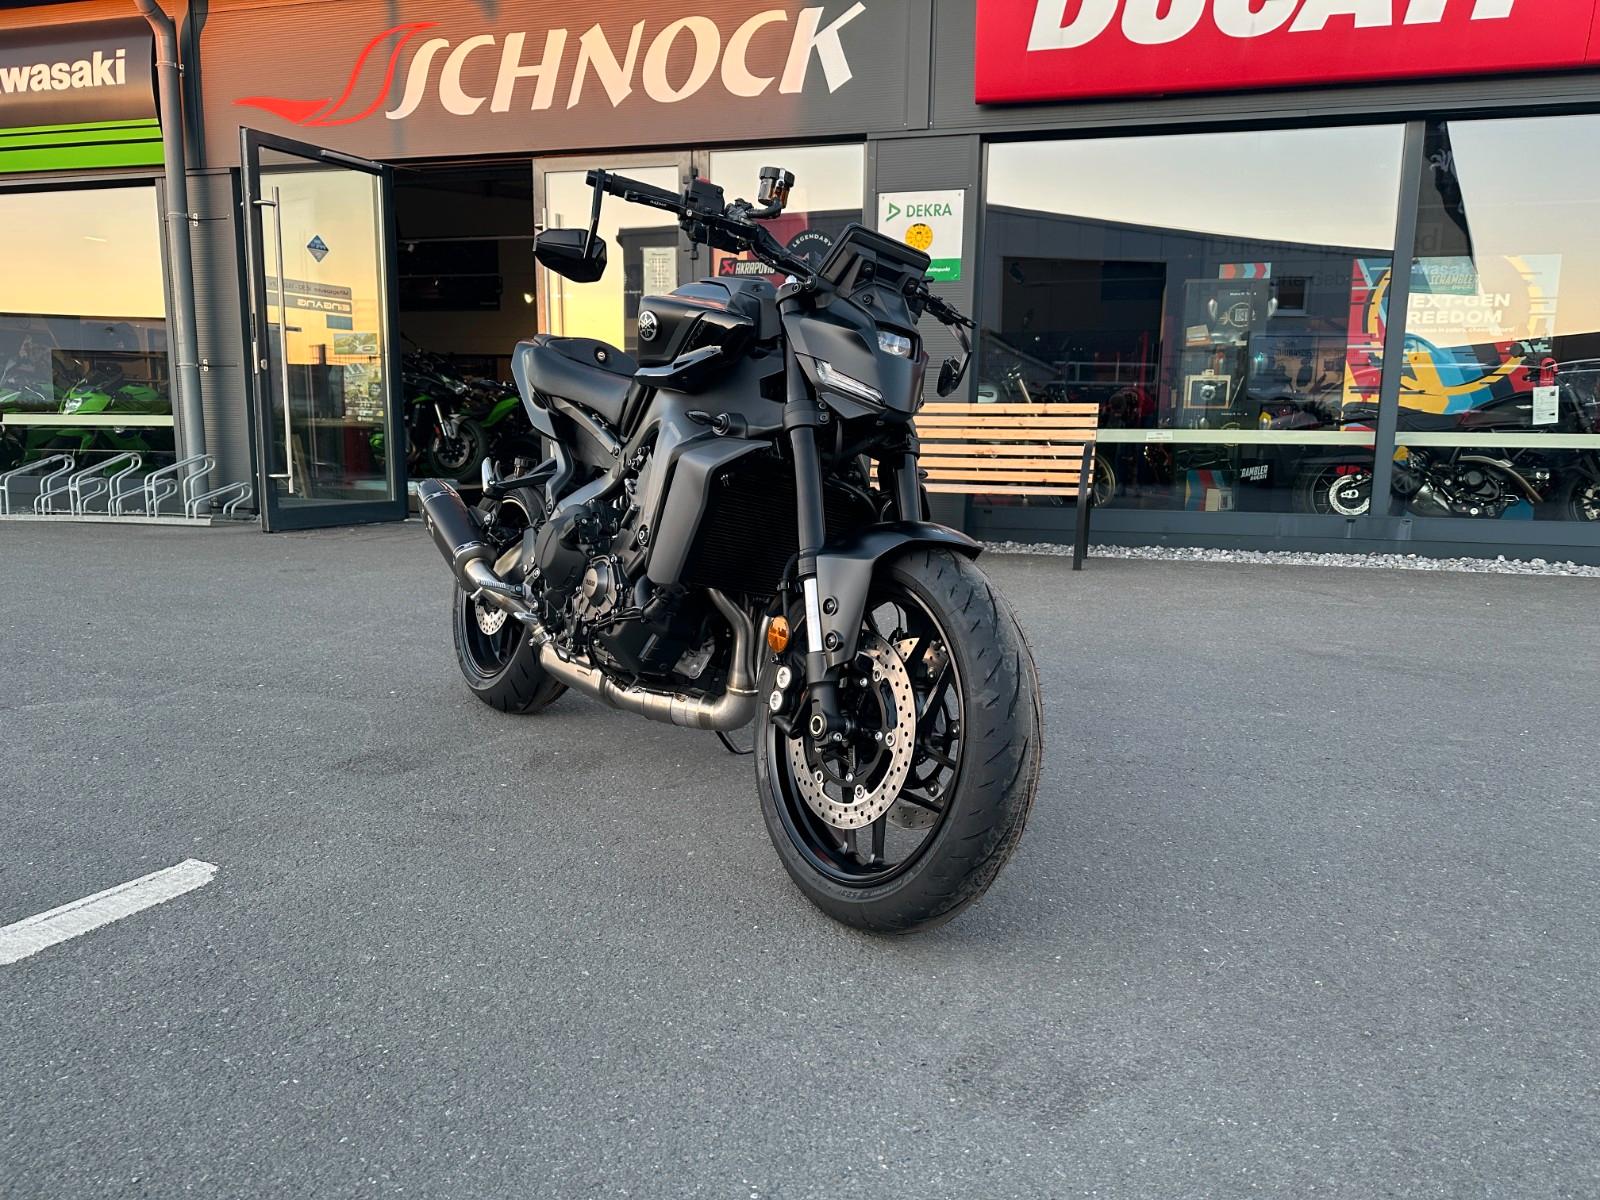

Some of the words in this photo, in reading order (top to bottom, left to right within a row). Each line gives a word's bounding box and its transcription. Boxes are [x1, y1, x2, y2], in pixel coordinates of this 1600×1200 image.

[1027, 0, 1516, 51] DUC
[385, 1, 866, 120] SCHNOCK
[0, 48, 126, 94] wasaki
[906, 203, 953, 218] DEKRA
[792, 233, 832, 248] LEGENDARY
[1409, 293, 1511, 308] EXT-GEN
[1407, 310, 1503, 324] REEDOM
[1240, 465, 1268, 478] RAMBLER
